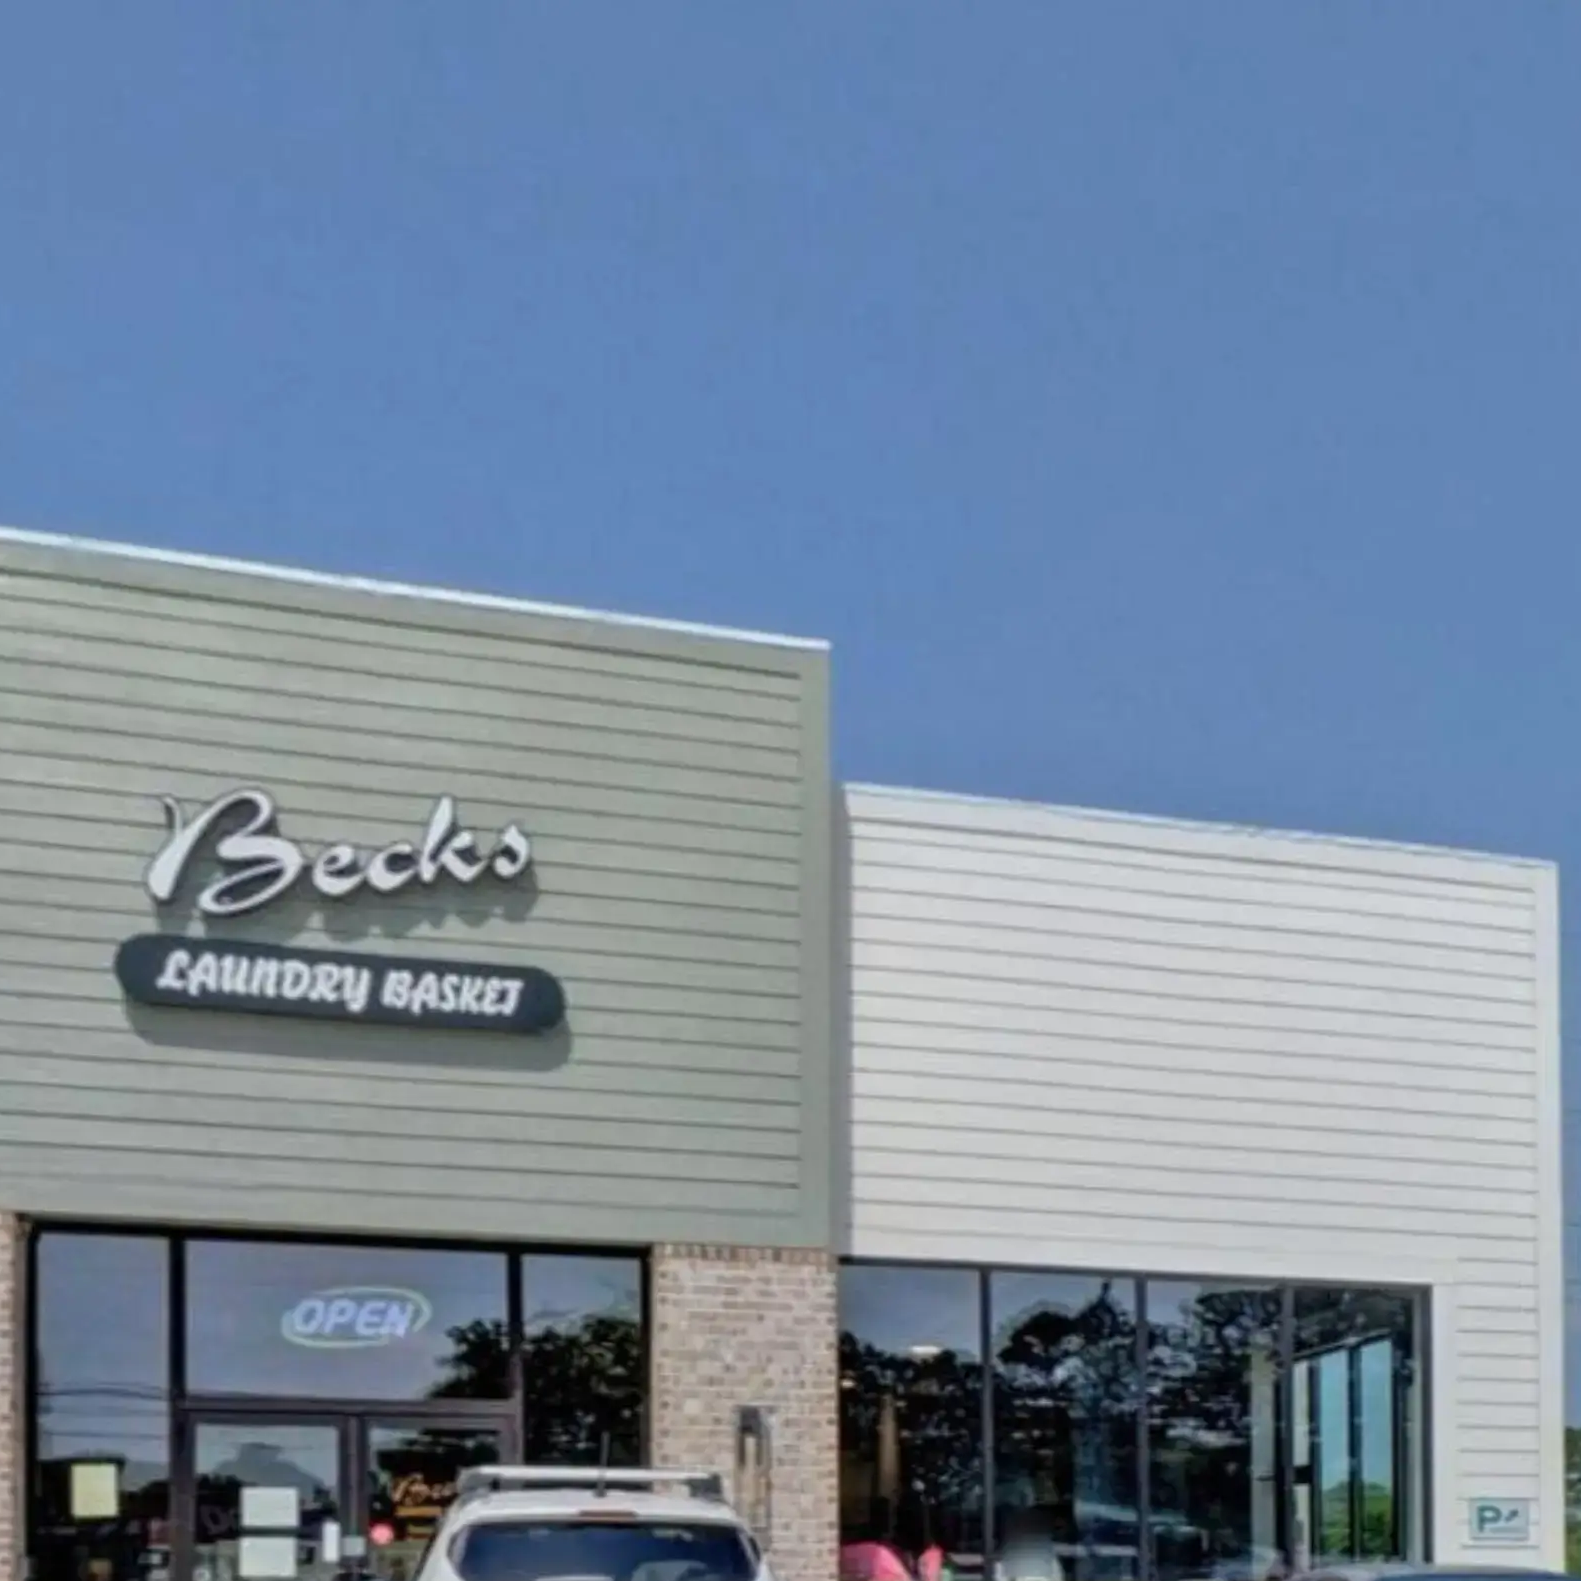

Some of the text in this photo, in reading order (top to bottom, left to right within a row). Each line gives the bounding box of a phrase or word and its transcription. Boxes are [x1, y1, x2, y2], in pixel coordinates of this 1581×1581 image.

[145, 788, 531, 914] Becks
[155, 948, 524, 1017] LAUNDRY BASKET
[291, 1298, 415, 1338] OPEN
